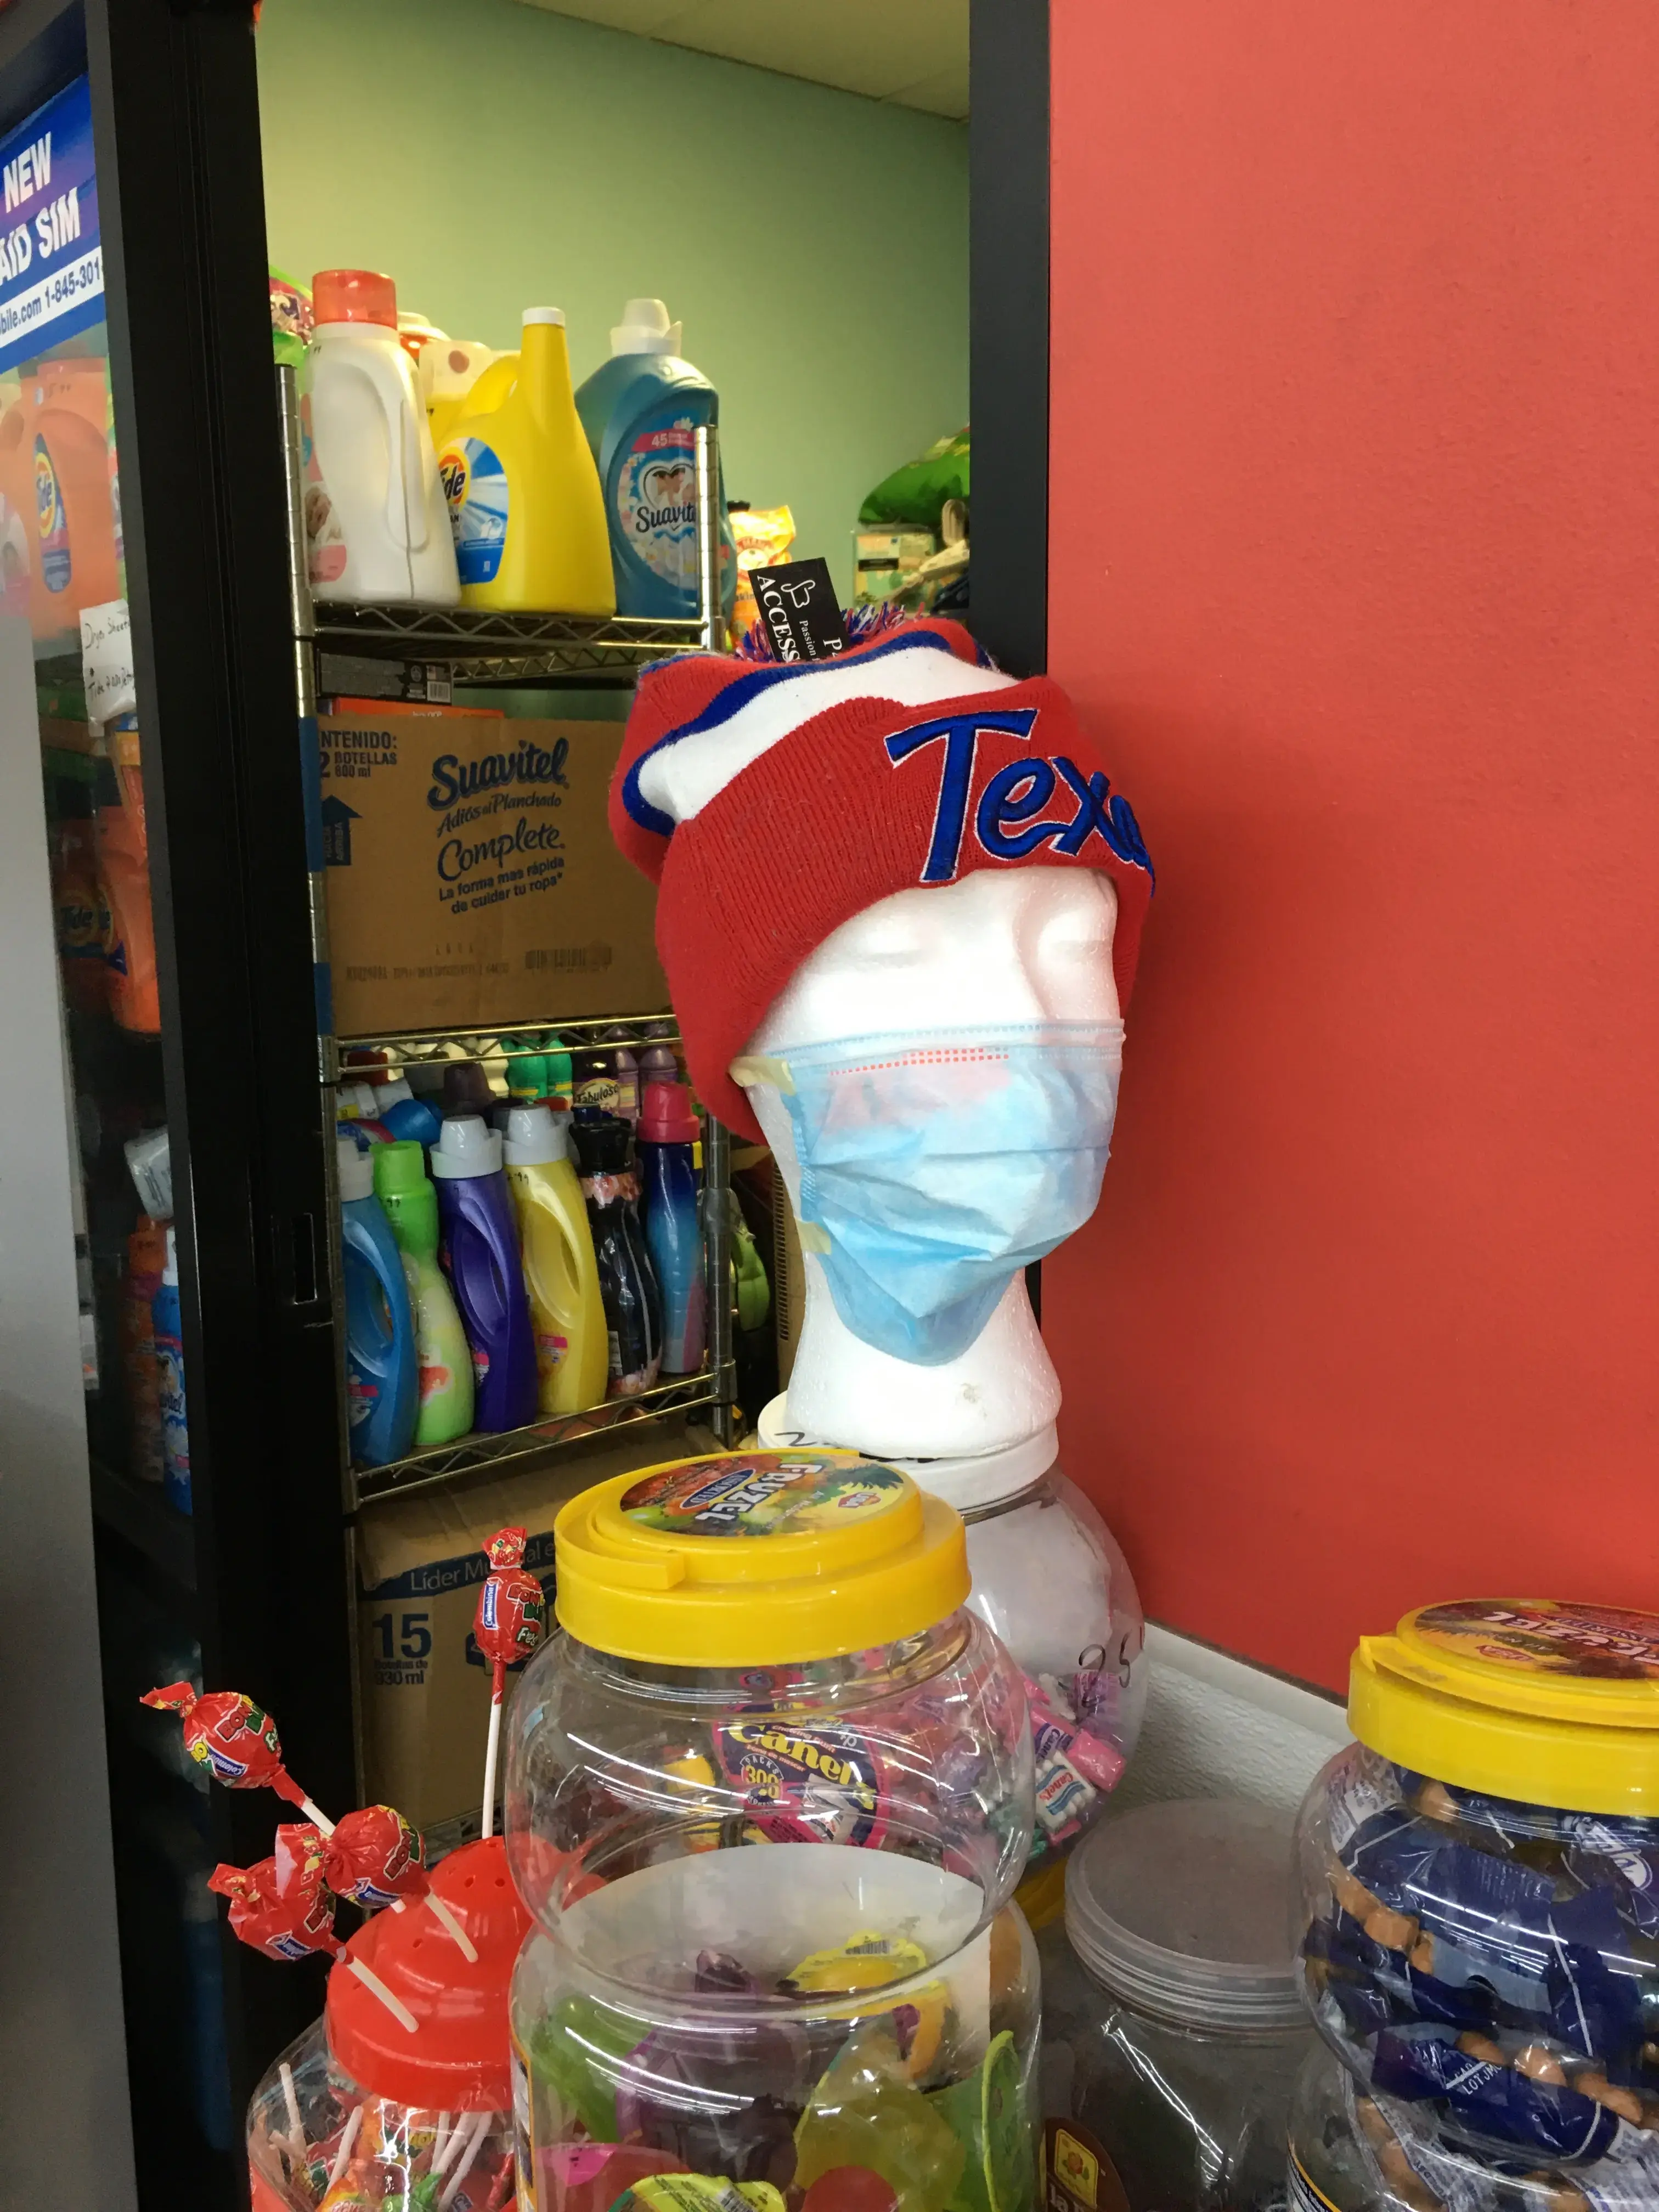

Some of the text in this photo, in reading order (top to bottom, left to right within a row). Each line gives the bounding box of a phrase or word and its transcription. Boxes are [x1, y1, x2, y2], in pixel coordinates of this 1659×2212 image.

[3, 131, 52, 213] NEW
[35, 186, 81, 259] SIM
[0, 296, 42, 335] bile.com
[651, 433, 669, 447] 45
[757, 574, 801, 663] ACCESS
[799, 619, 817, 657] Passion
[319, 730, 398, 749] NTENIDO:
[319, 751, 398, 778] 2 BOTELLAS
[427, 737, 569, 811] Suavitel
[492, 791, 562, 814] Planchado
[439, 887, 454, 901] La
[458, 878, 494, 896] forma
[451, 900, 468, 914] de
[471, 888, 511, 909] cuidar
[514, 883, 527, 896] tu
[774, 1431, 817, 1447] 2
[695, 1463, 827, 1522] FRUZEL
[410, 1570, 458, 1592] Líder
[373, 1613, 432, 1658] 15
[405, 1669, 425, 1685] ml
[744, 1753, 780, 1776] PACKS
